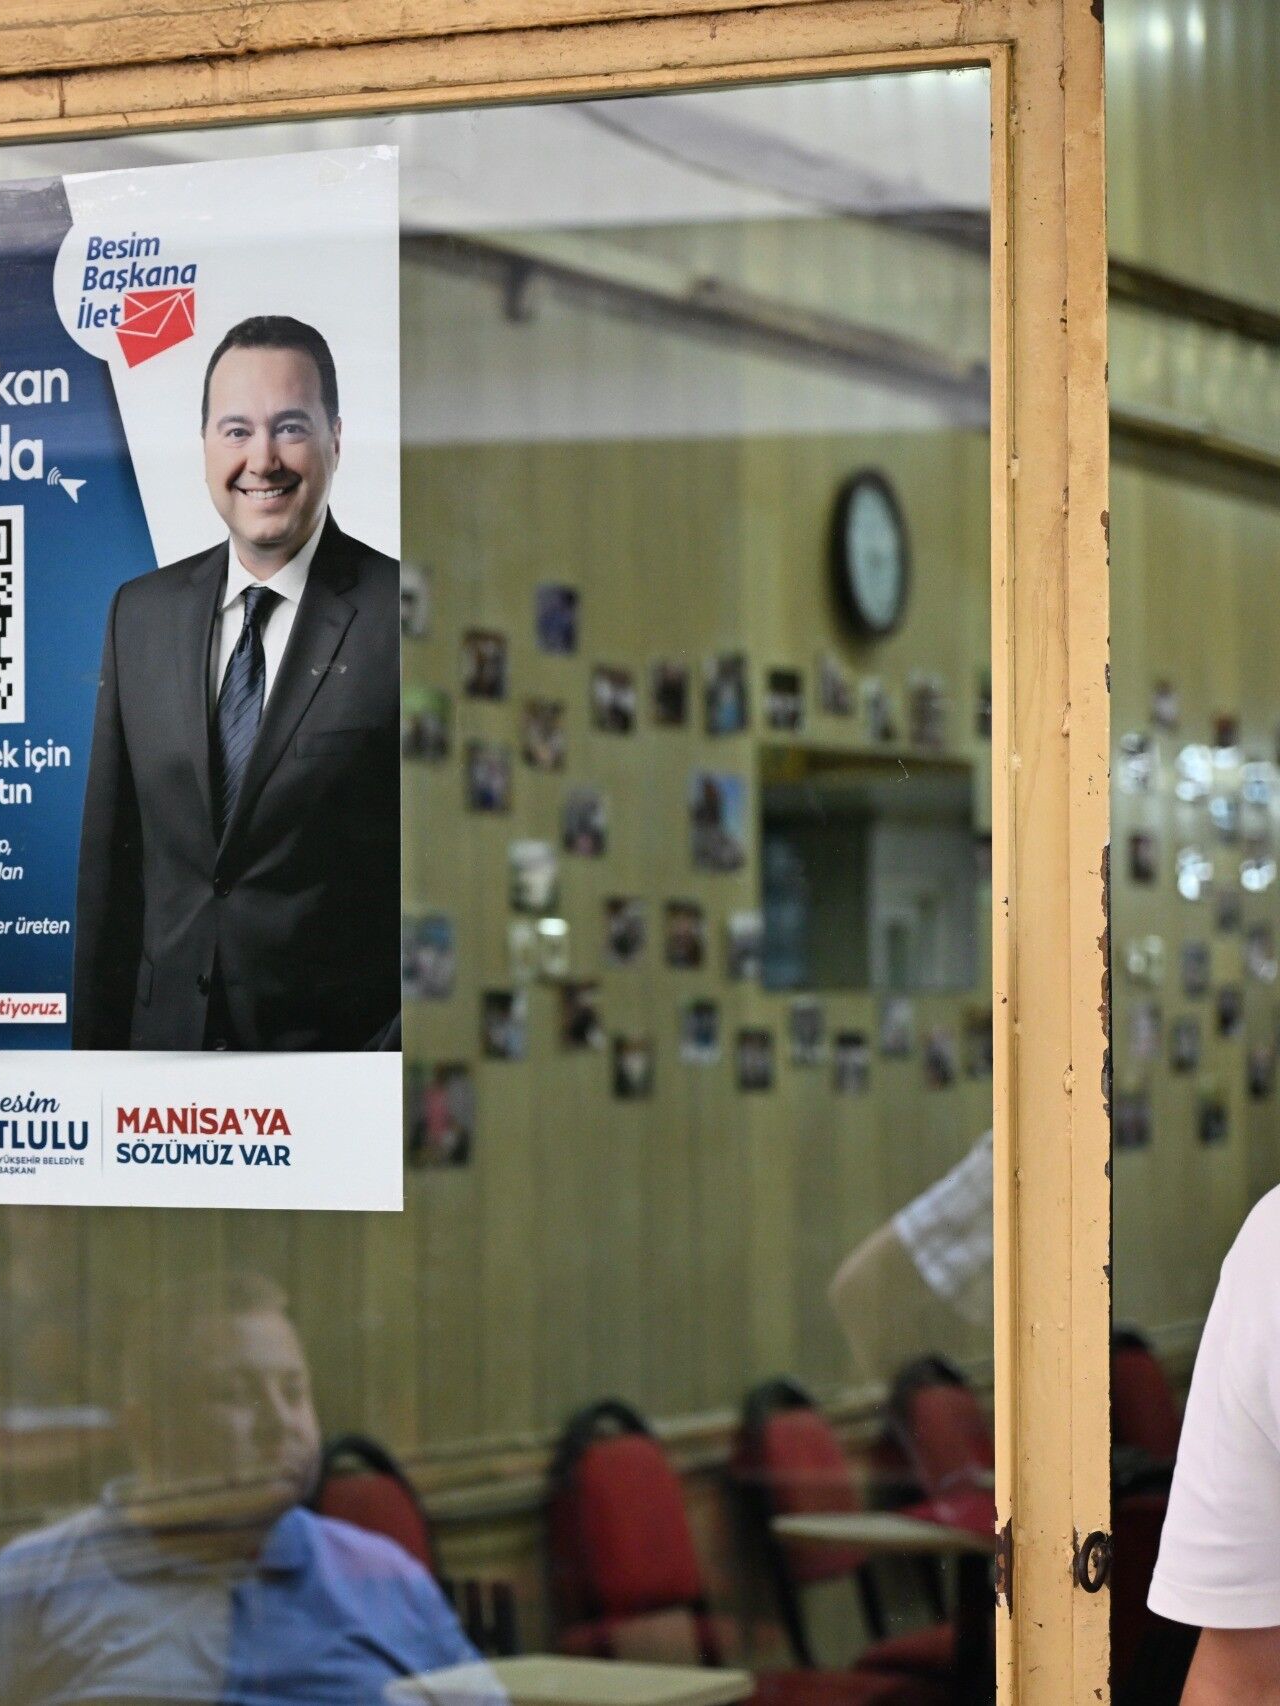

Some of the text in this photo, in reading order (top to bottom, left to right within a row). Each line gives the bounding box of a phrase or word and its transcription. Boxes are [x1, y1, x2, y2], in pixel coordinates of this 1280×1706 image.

[86, 231, 161, 261] Besim
[82, 262, 197, 293] Başkana
[77, 297, 121, 329] İlet
[24, 739, 71, 773] için
[15, 917, 70, 935] üreten
[116, 1102, 292, 1136] MANİSA'YA
[42, 1156, 85, 1166] BELEDİYE
[116, 1138, 291, 1166] SÖZÜMÜZ VAR
